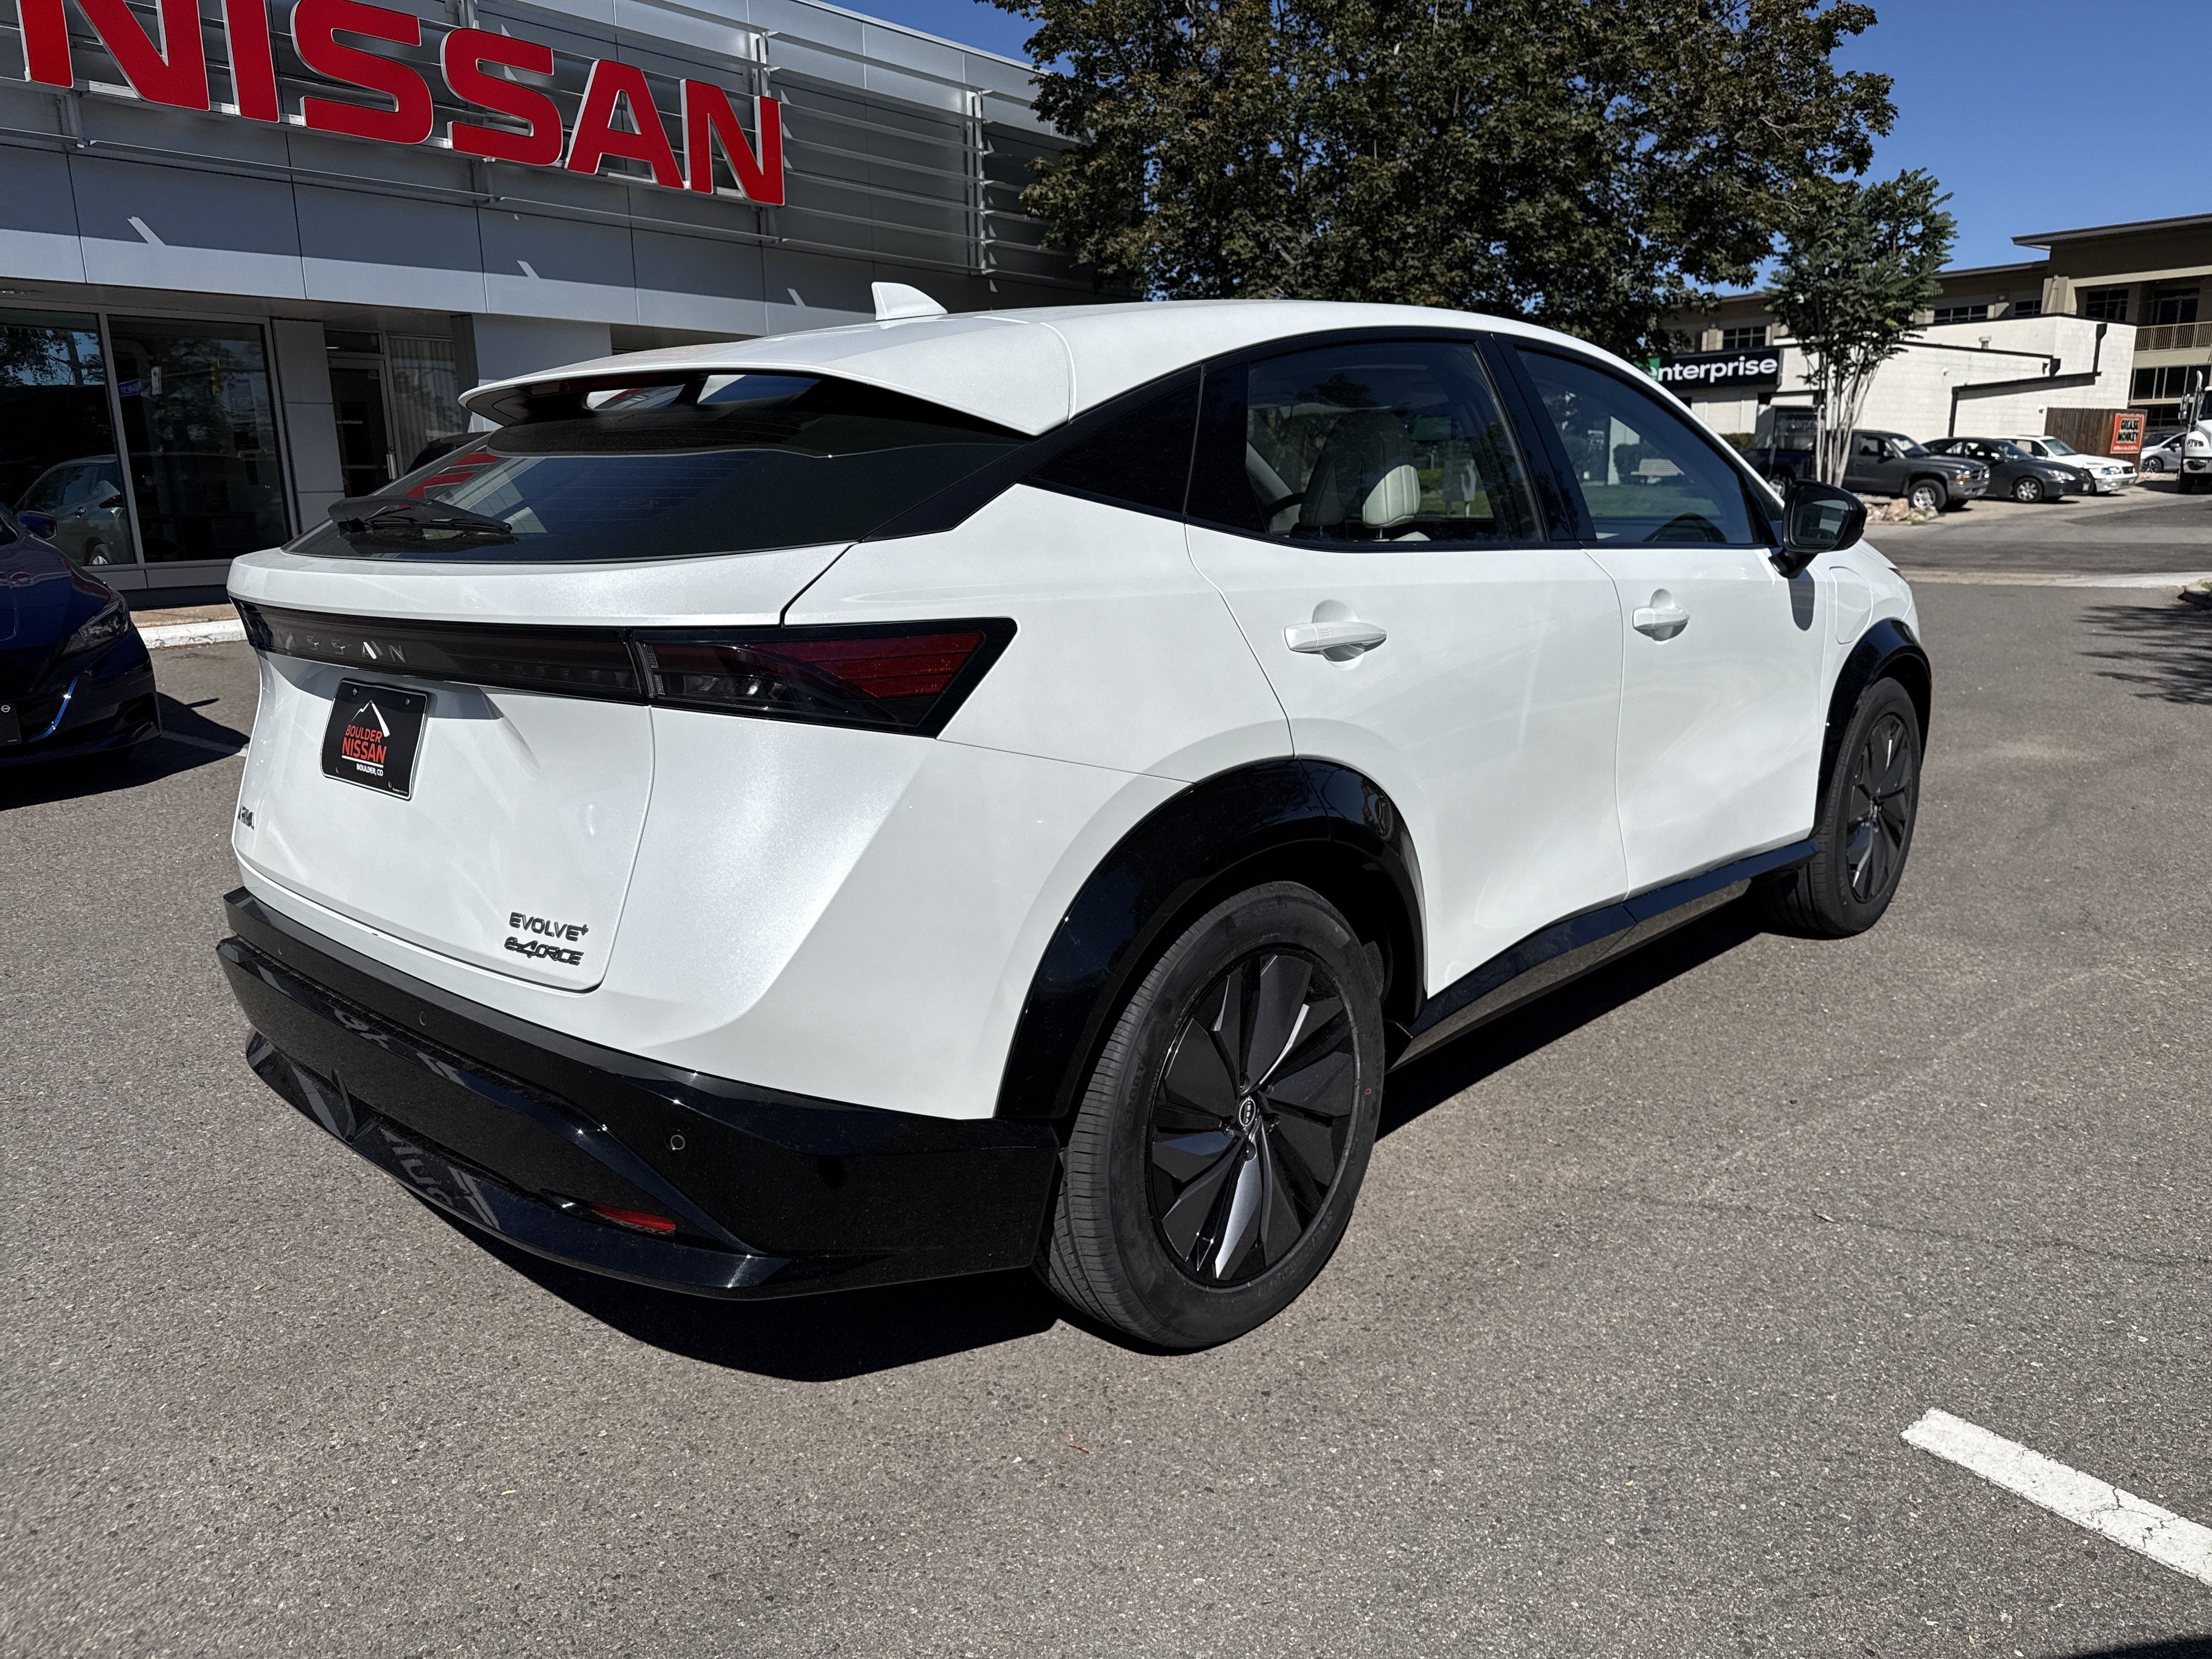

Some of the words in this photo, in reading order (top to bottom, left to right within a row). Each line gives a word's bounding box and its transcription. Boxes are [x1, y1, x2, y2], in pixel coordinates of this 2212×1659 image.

[16, 0, 786, 207] NISSAN
[345, 724, 383, 744] BOULDER
[342, 737, 387, 764] NISSAN
[356, 763, 377, 776] BOULDER,
[377, 769, 383, 777] CO
